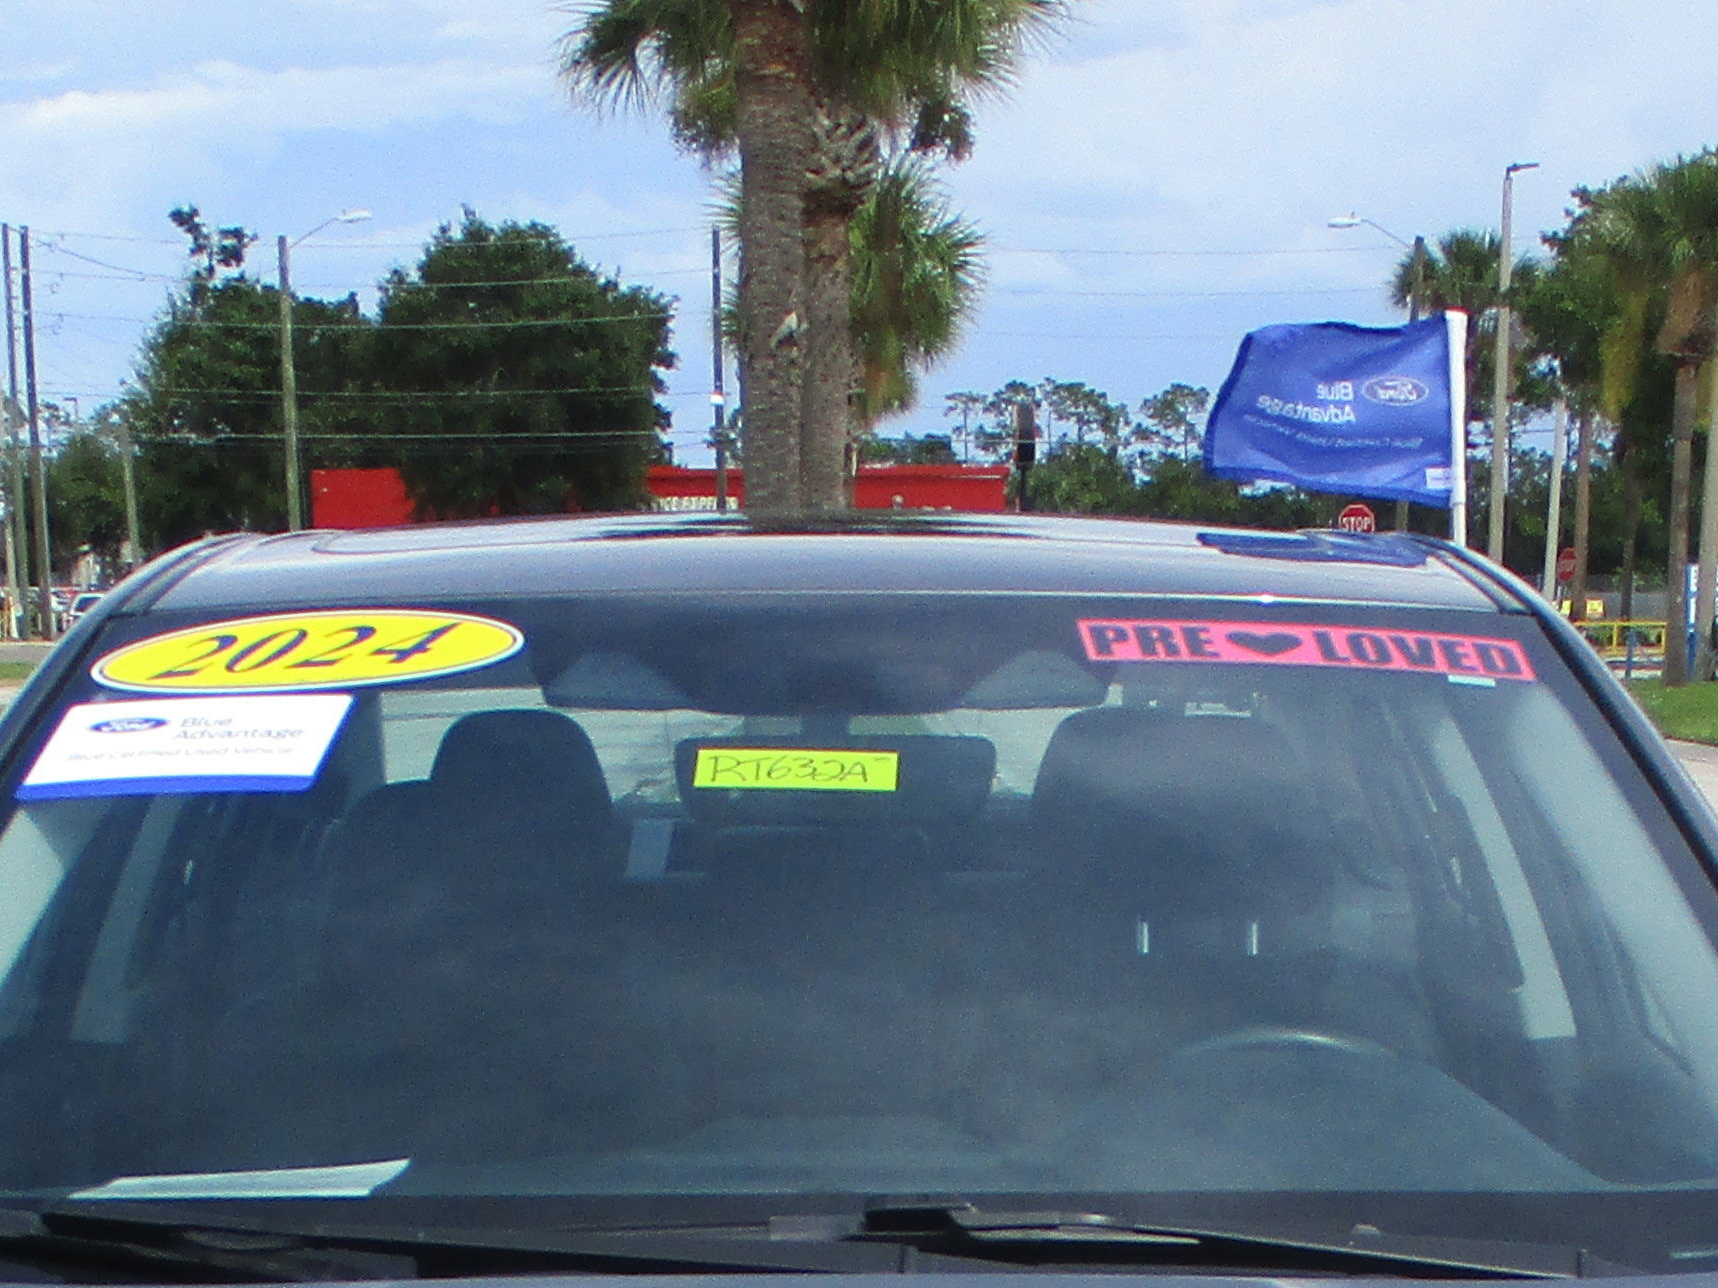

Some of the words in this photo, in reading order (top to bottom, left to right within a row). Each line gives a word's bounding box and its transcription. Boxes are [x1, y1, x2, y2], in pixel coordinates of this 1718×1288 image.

[1343, 516, 1371, 531] STOP
[146, 620, 464, 680] 2024
[1087, 623, 1221, 659] PRE
[1312, 629, 1522, 675] LOVED
[180, 717, 233, 728] Blue
[172, 728, 305, 740] Advantage
